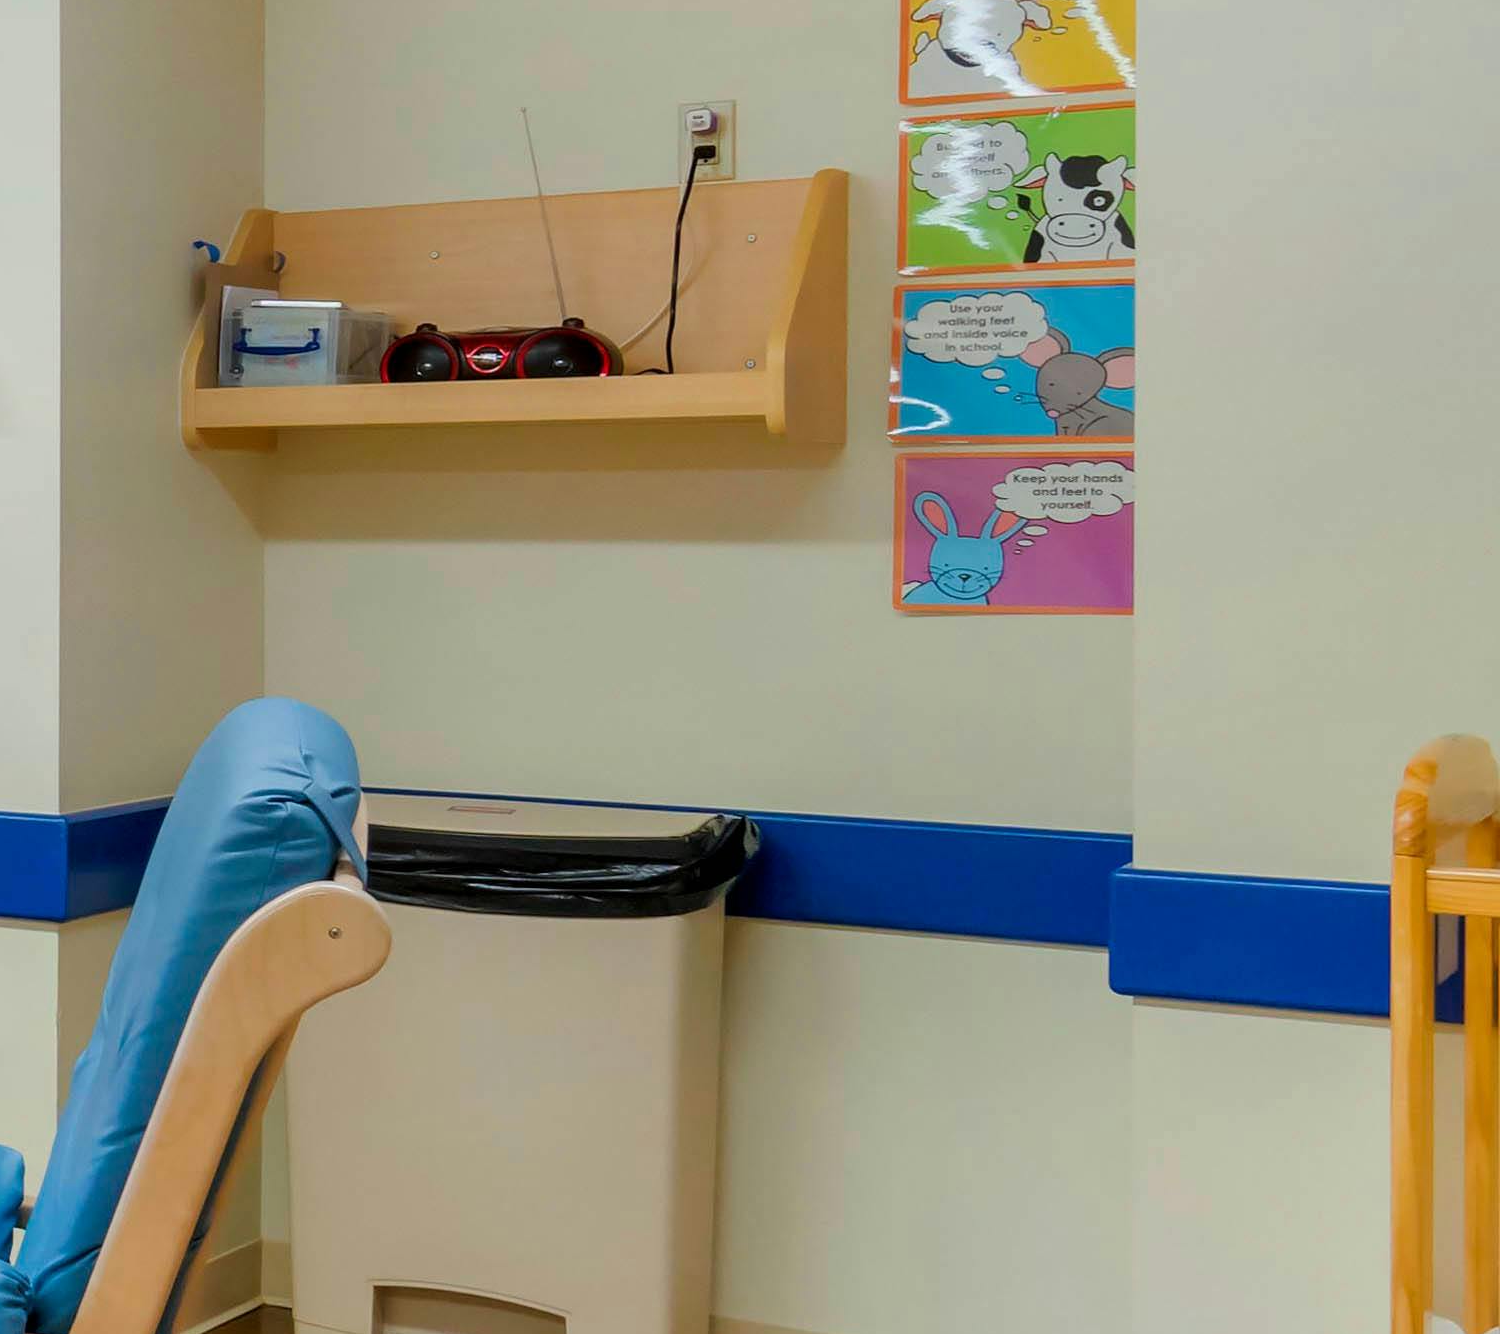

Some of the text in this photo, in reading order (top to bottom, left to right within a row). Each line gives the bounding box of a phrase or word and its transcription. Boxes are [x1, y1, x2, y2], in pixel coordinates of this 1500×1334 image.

[950, 304, 1004, 314] Use your
[938, 316, 1015, 328] walking feet
[924, 329, 1029, 339] and inside voice
[944, 342, 956, 352] in
[1013, 474, 1124, 485] Keep your hands
[1032, 487, 1104, 496] and feet to
